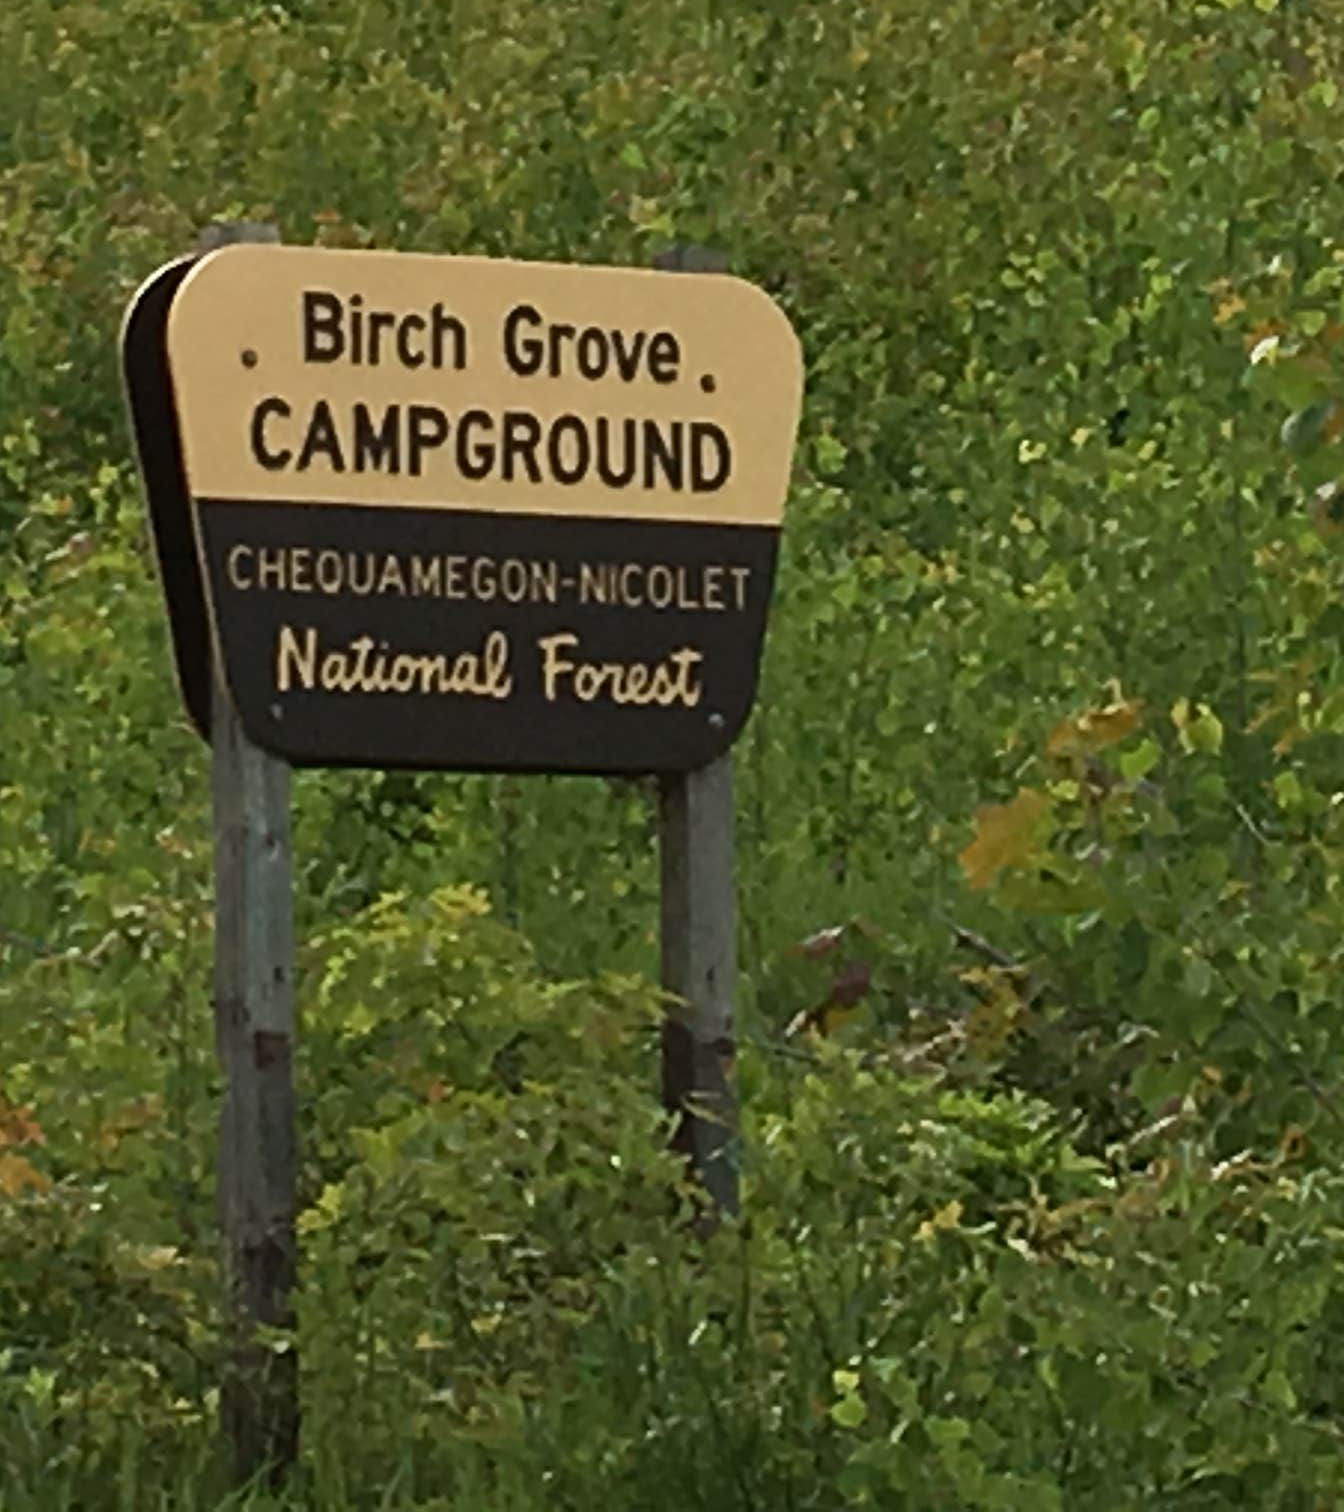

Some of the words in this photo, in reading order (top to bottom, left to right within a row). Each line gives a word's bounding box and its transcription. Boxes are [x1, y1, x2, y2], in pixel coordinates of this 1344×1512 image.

[302, 291, 467, 369] Birch
[503, 304, 681, 384] Grove
[250, 398, 732, 492] CAMPGROUND
[228, 544, 751, 612] CHEQUAMEGON-NICOLET
[276, 625, 512, 700] National
[538, 634, 704, 707] Forest
